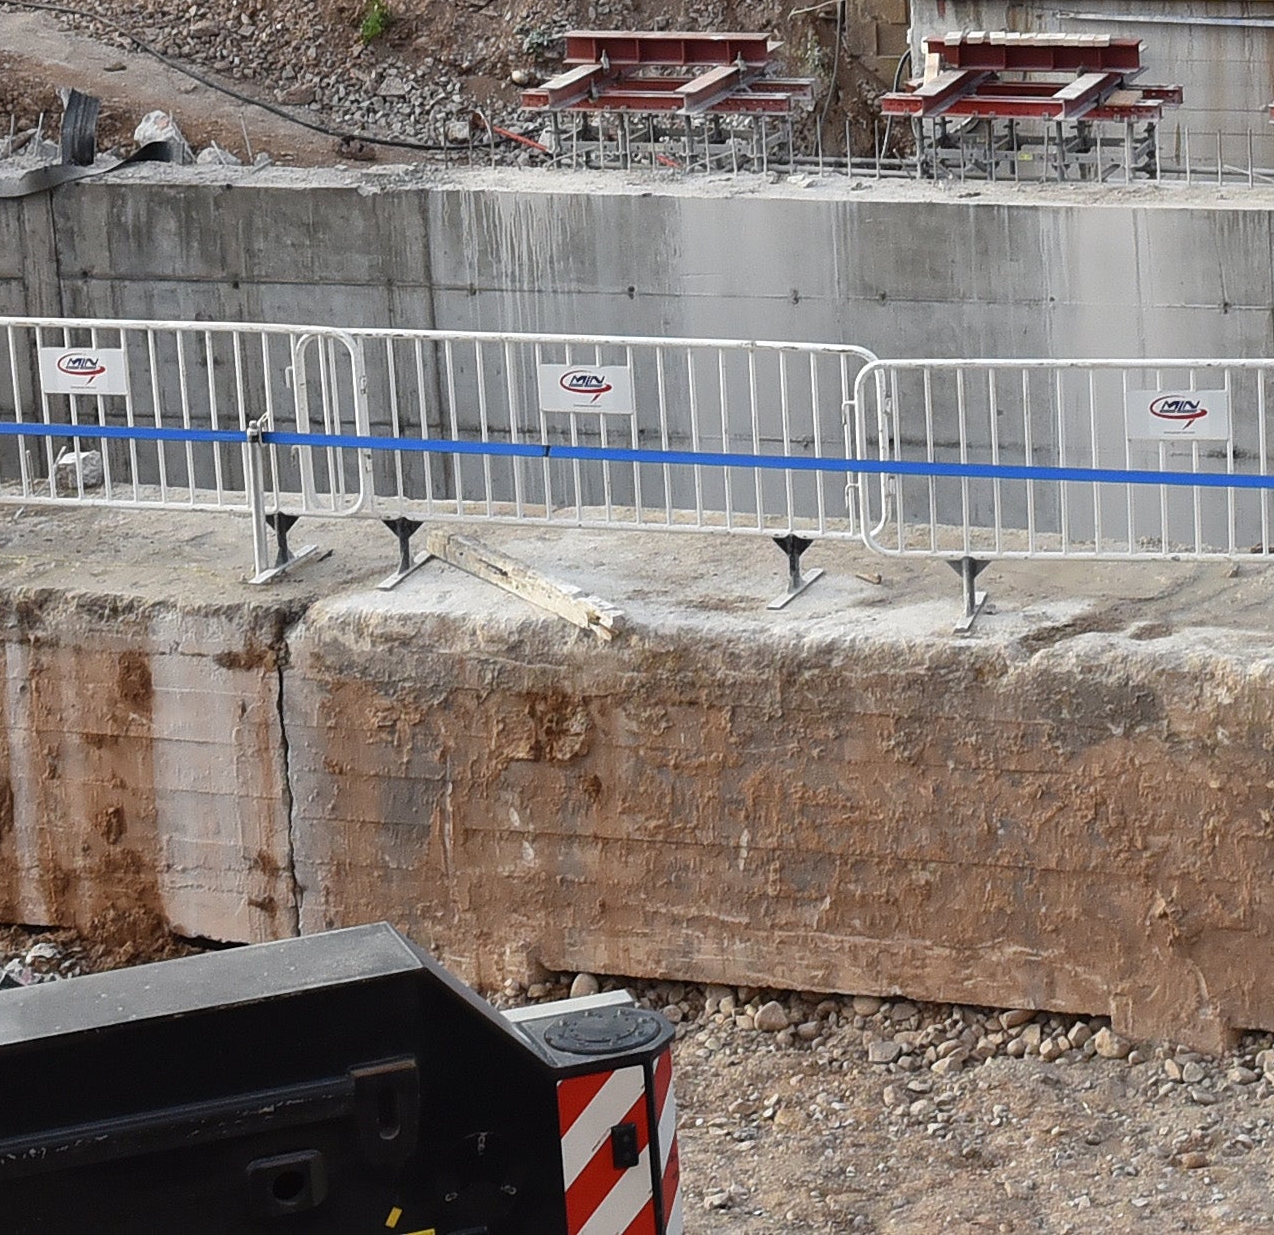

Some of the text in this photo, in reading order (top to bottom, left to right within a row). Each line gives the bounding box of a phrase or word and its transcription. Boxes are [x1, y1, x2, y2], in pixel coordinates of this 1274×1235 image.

[67, 357, 99, 369] MIN
[568, 375, 606, 387] MIN
[1159, 400, 1200, 413] MIN
